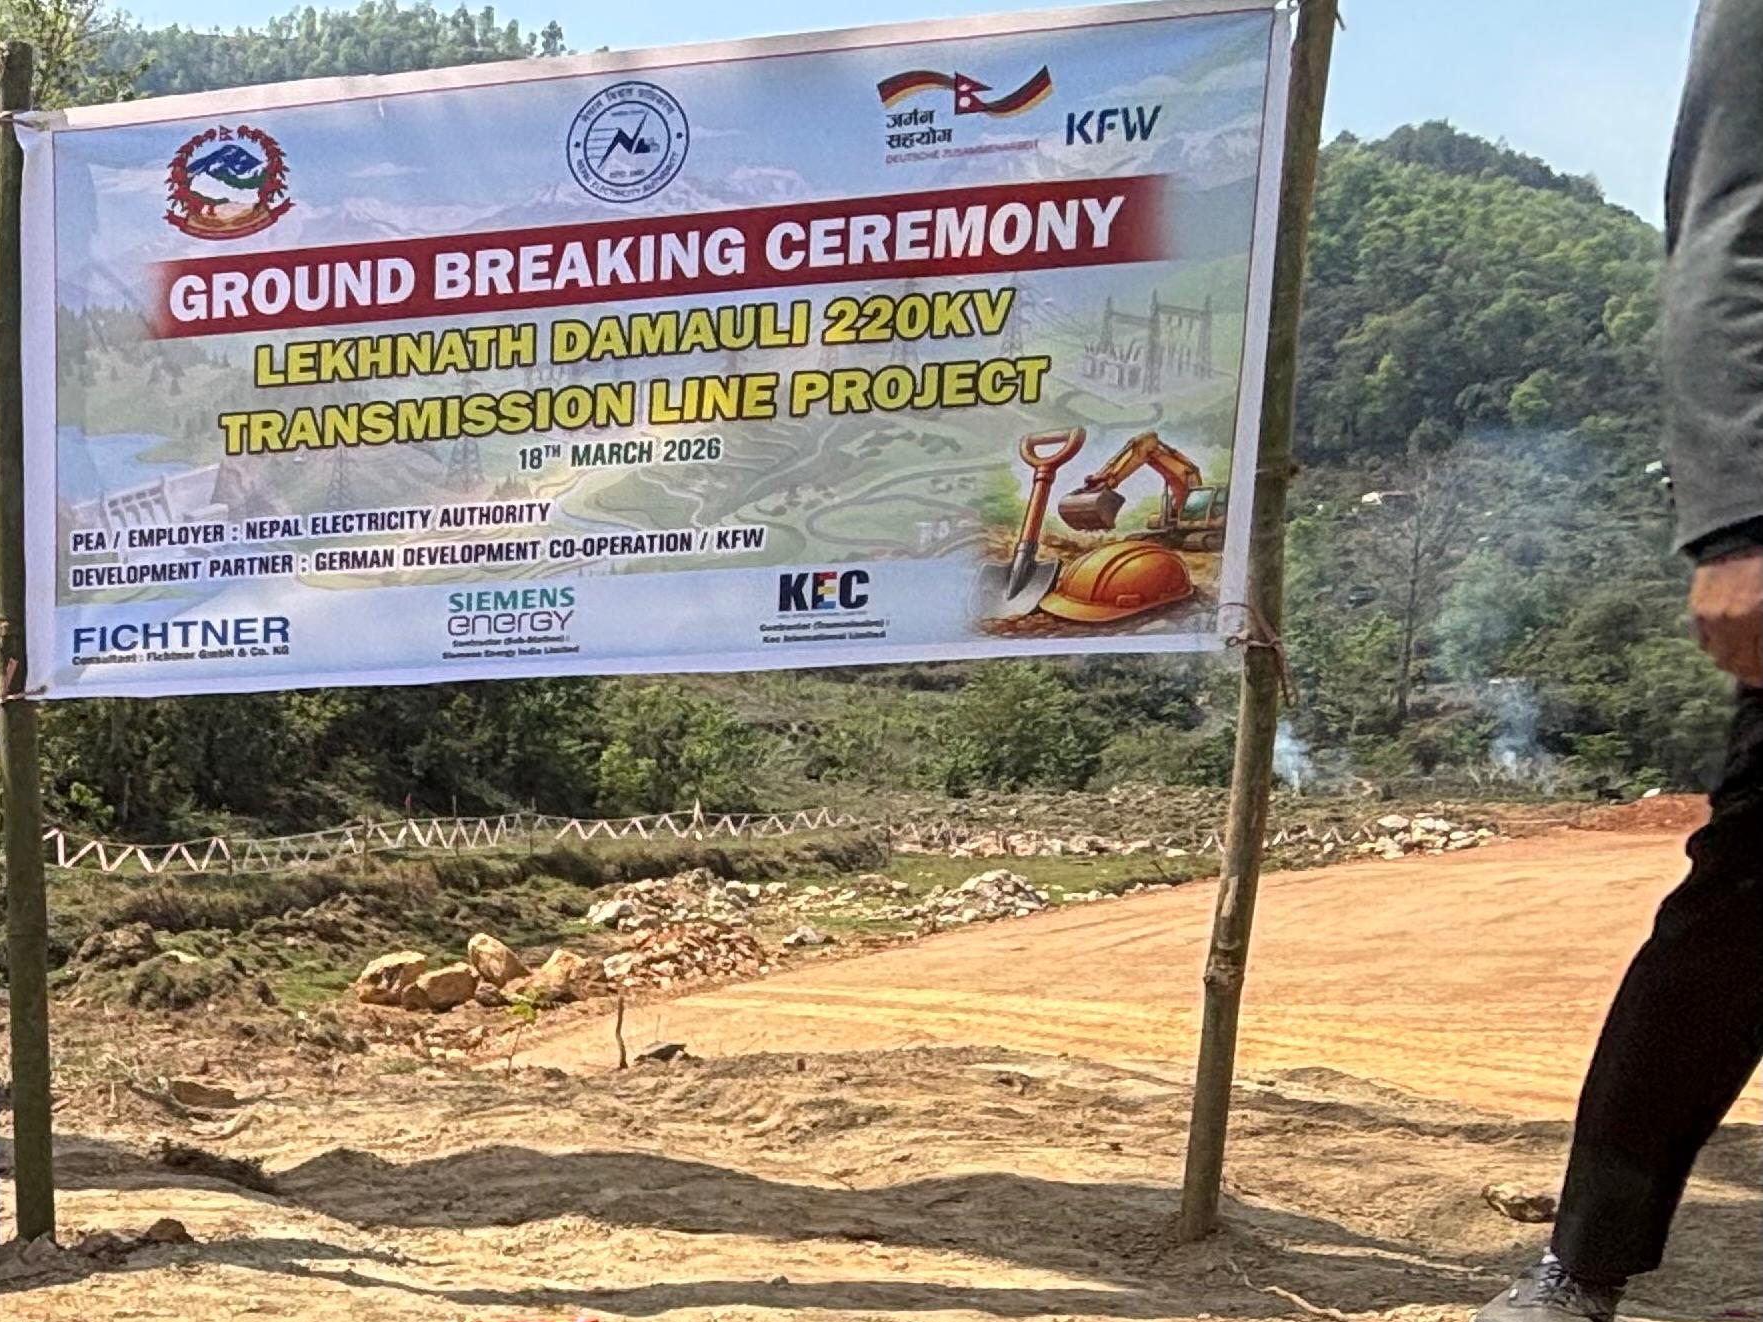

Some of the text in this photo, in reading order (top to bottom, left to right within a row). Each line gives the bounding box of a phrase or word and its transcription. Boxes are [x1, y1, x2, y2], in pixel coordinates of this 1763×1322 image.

[1066, 105, 1162, 145] KFW
[170, 196, 1125, 322] GROUND BREAKING CEREMONY
[255, 288, 1015, 388] LEKHNATH DAMAULI 220KV
[221, 356, 1050, 456] TRANSMISSION LINE PROJECT
[519, 437, 721, 471] 18TH MARCH 2026
[72, 532, 107, 552] PEA
[113, 531, 121, 549] /
[128, 524, 225, 548] EMPLOYER
[246, 518, 303, 540] NEPAL
[311, 509, 430, 535] ELECTRICITY
[439, 503, 550, 527] AUTHORITY
[72, 561, 200, 588] DEVELOPMENT
[209, 554, 293, 578] PARTNER
[315, 548, 394, 572] GERMAN
[403, 540, 539, 566] DEVELOPMENT
[550, 532, 692, 558] CO-OPERATION
[699, 531, 709, 550] /
[716, 527, 765, 550] KFW
[449, 587, 574, 613] SIEMENS
[779, 569, 869, 611] KEC
[73, 616, 290, 653] FICHTNER
[198, 648, 235, 660] GmbH
